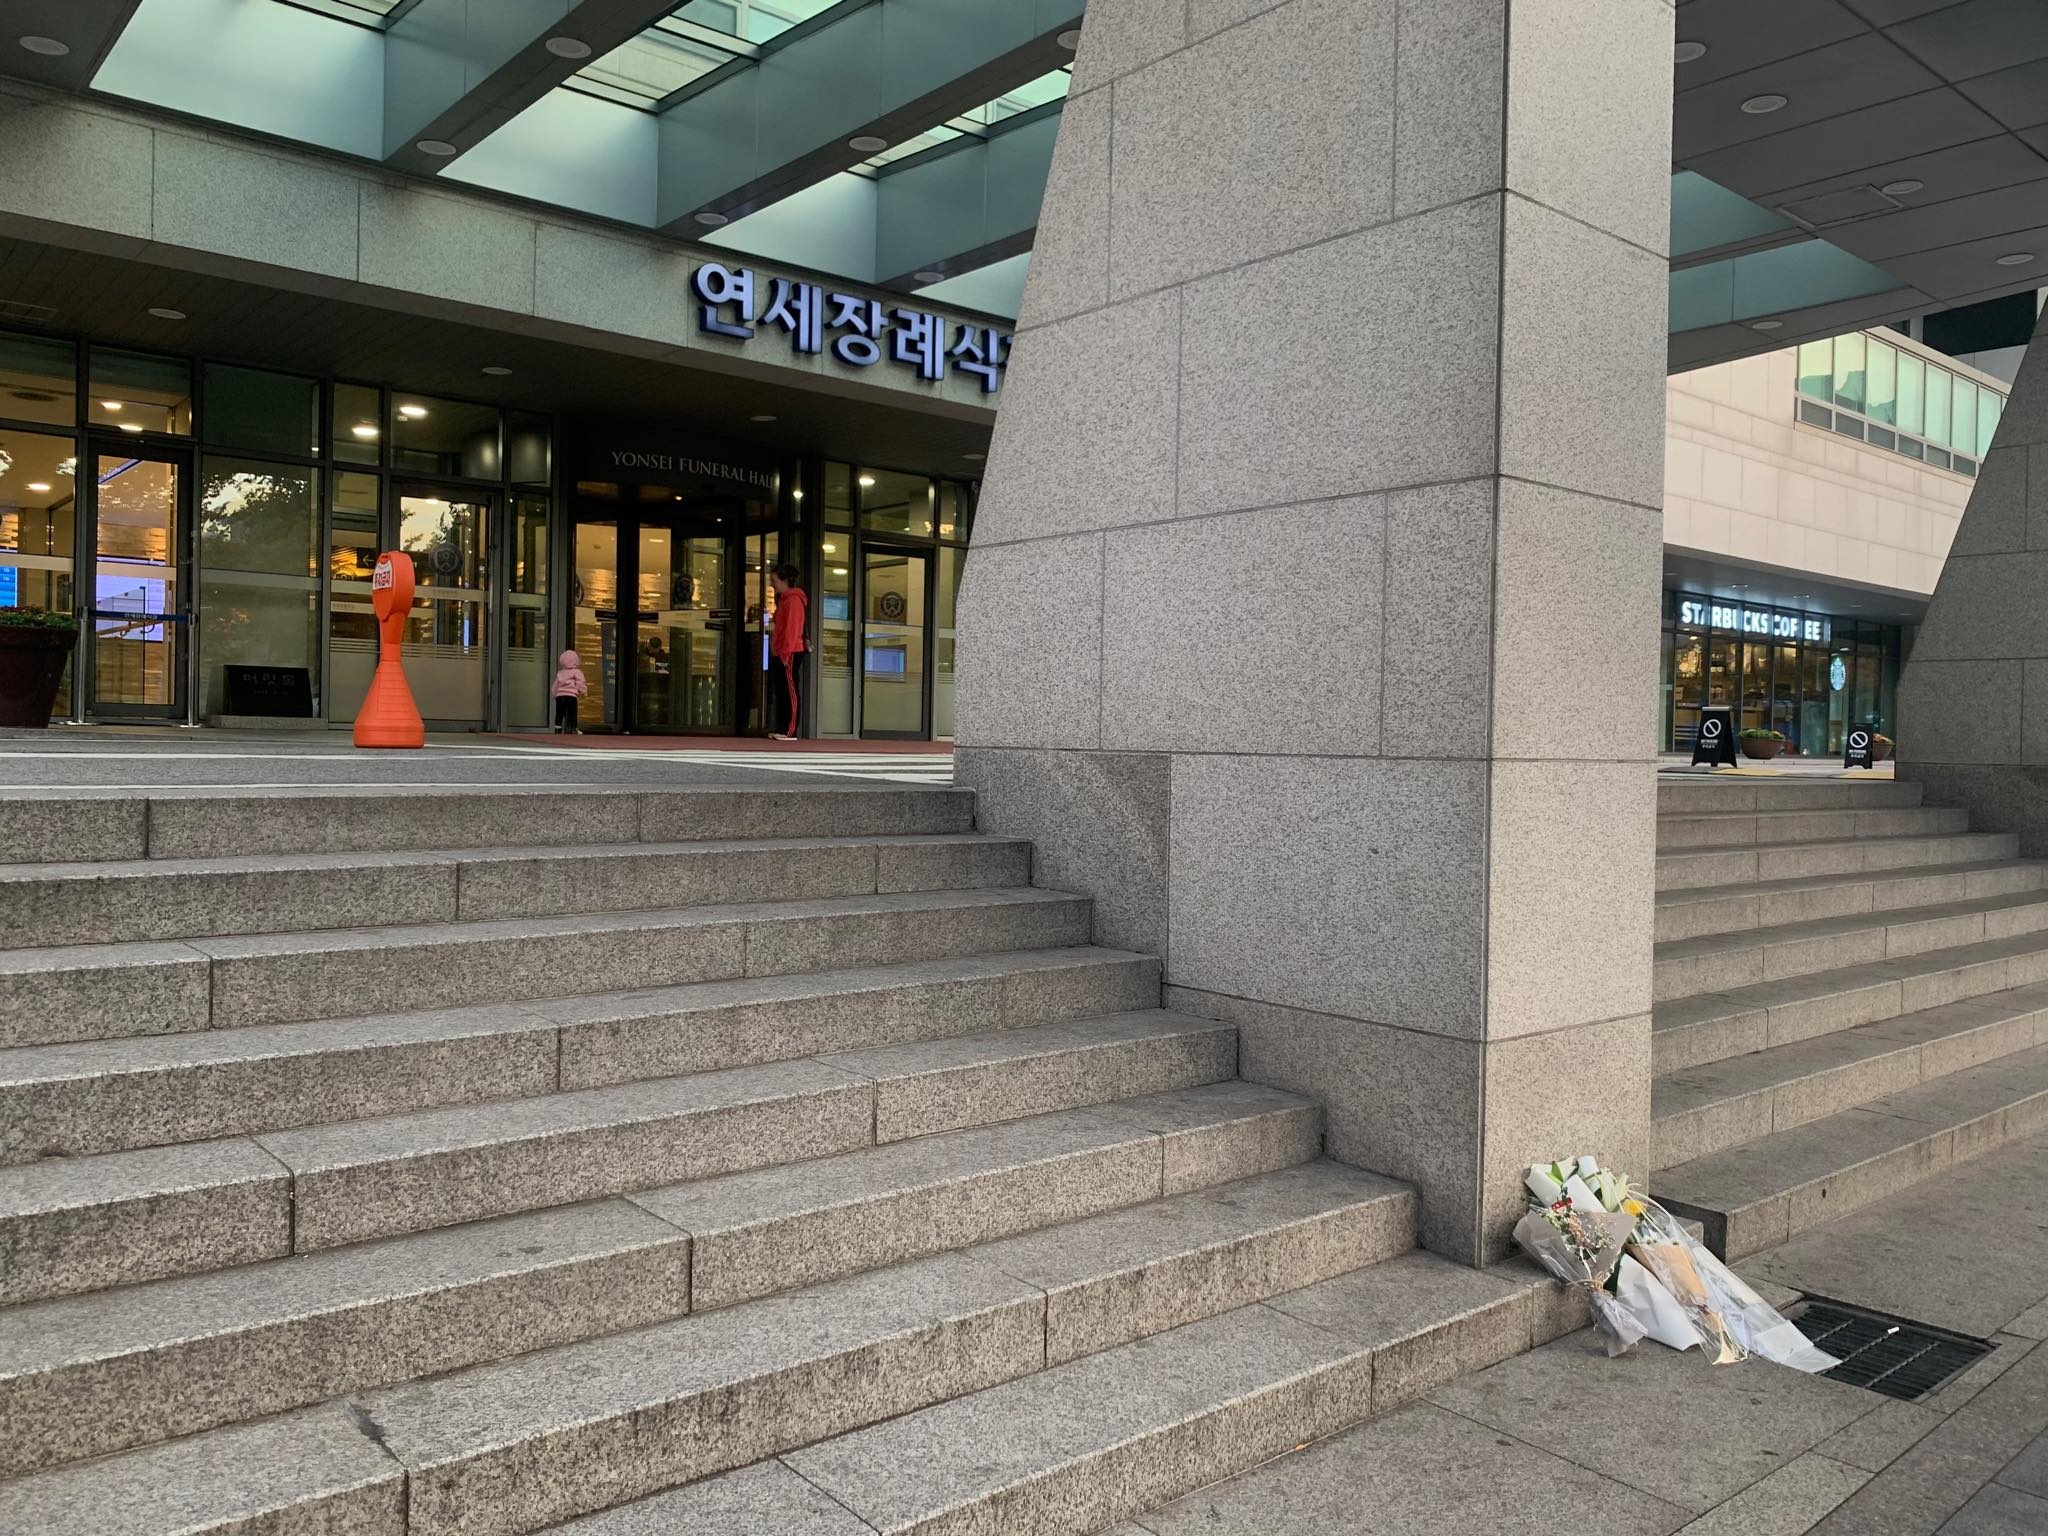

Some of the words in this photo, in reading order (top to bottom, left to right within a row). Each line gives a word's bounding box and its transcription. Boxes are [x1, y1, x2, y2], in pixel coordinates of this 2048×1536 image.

[693, 262, 1013, 393] 연세장례식
[611, 450, 673, 471] YONSEI
[679, 457, 747, 483] FUNERAL
[1774, 615, 1821, 641] COFEE
